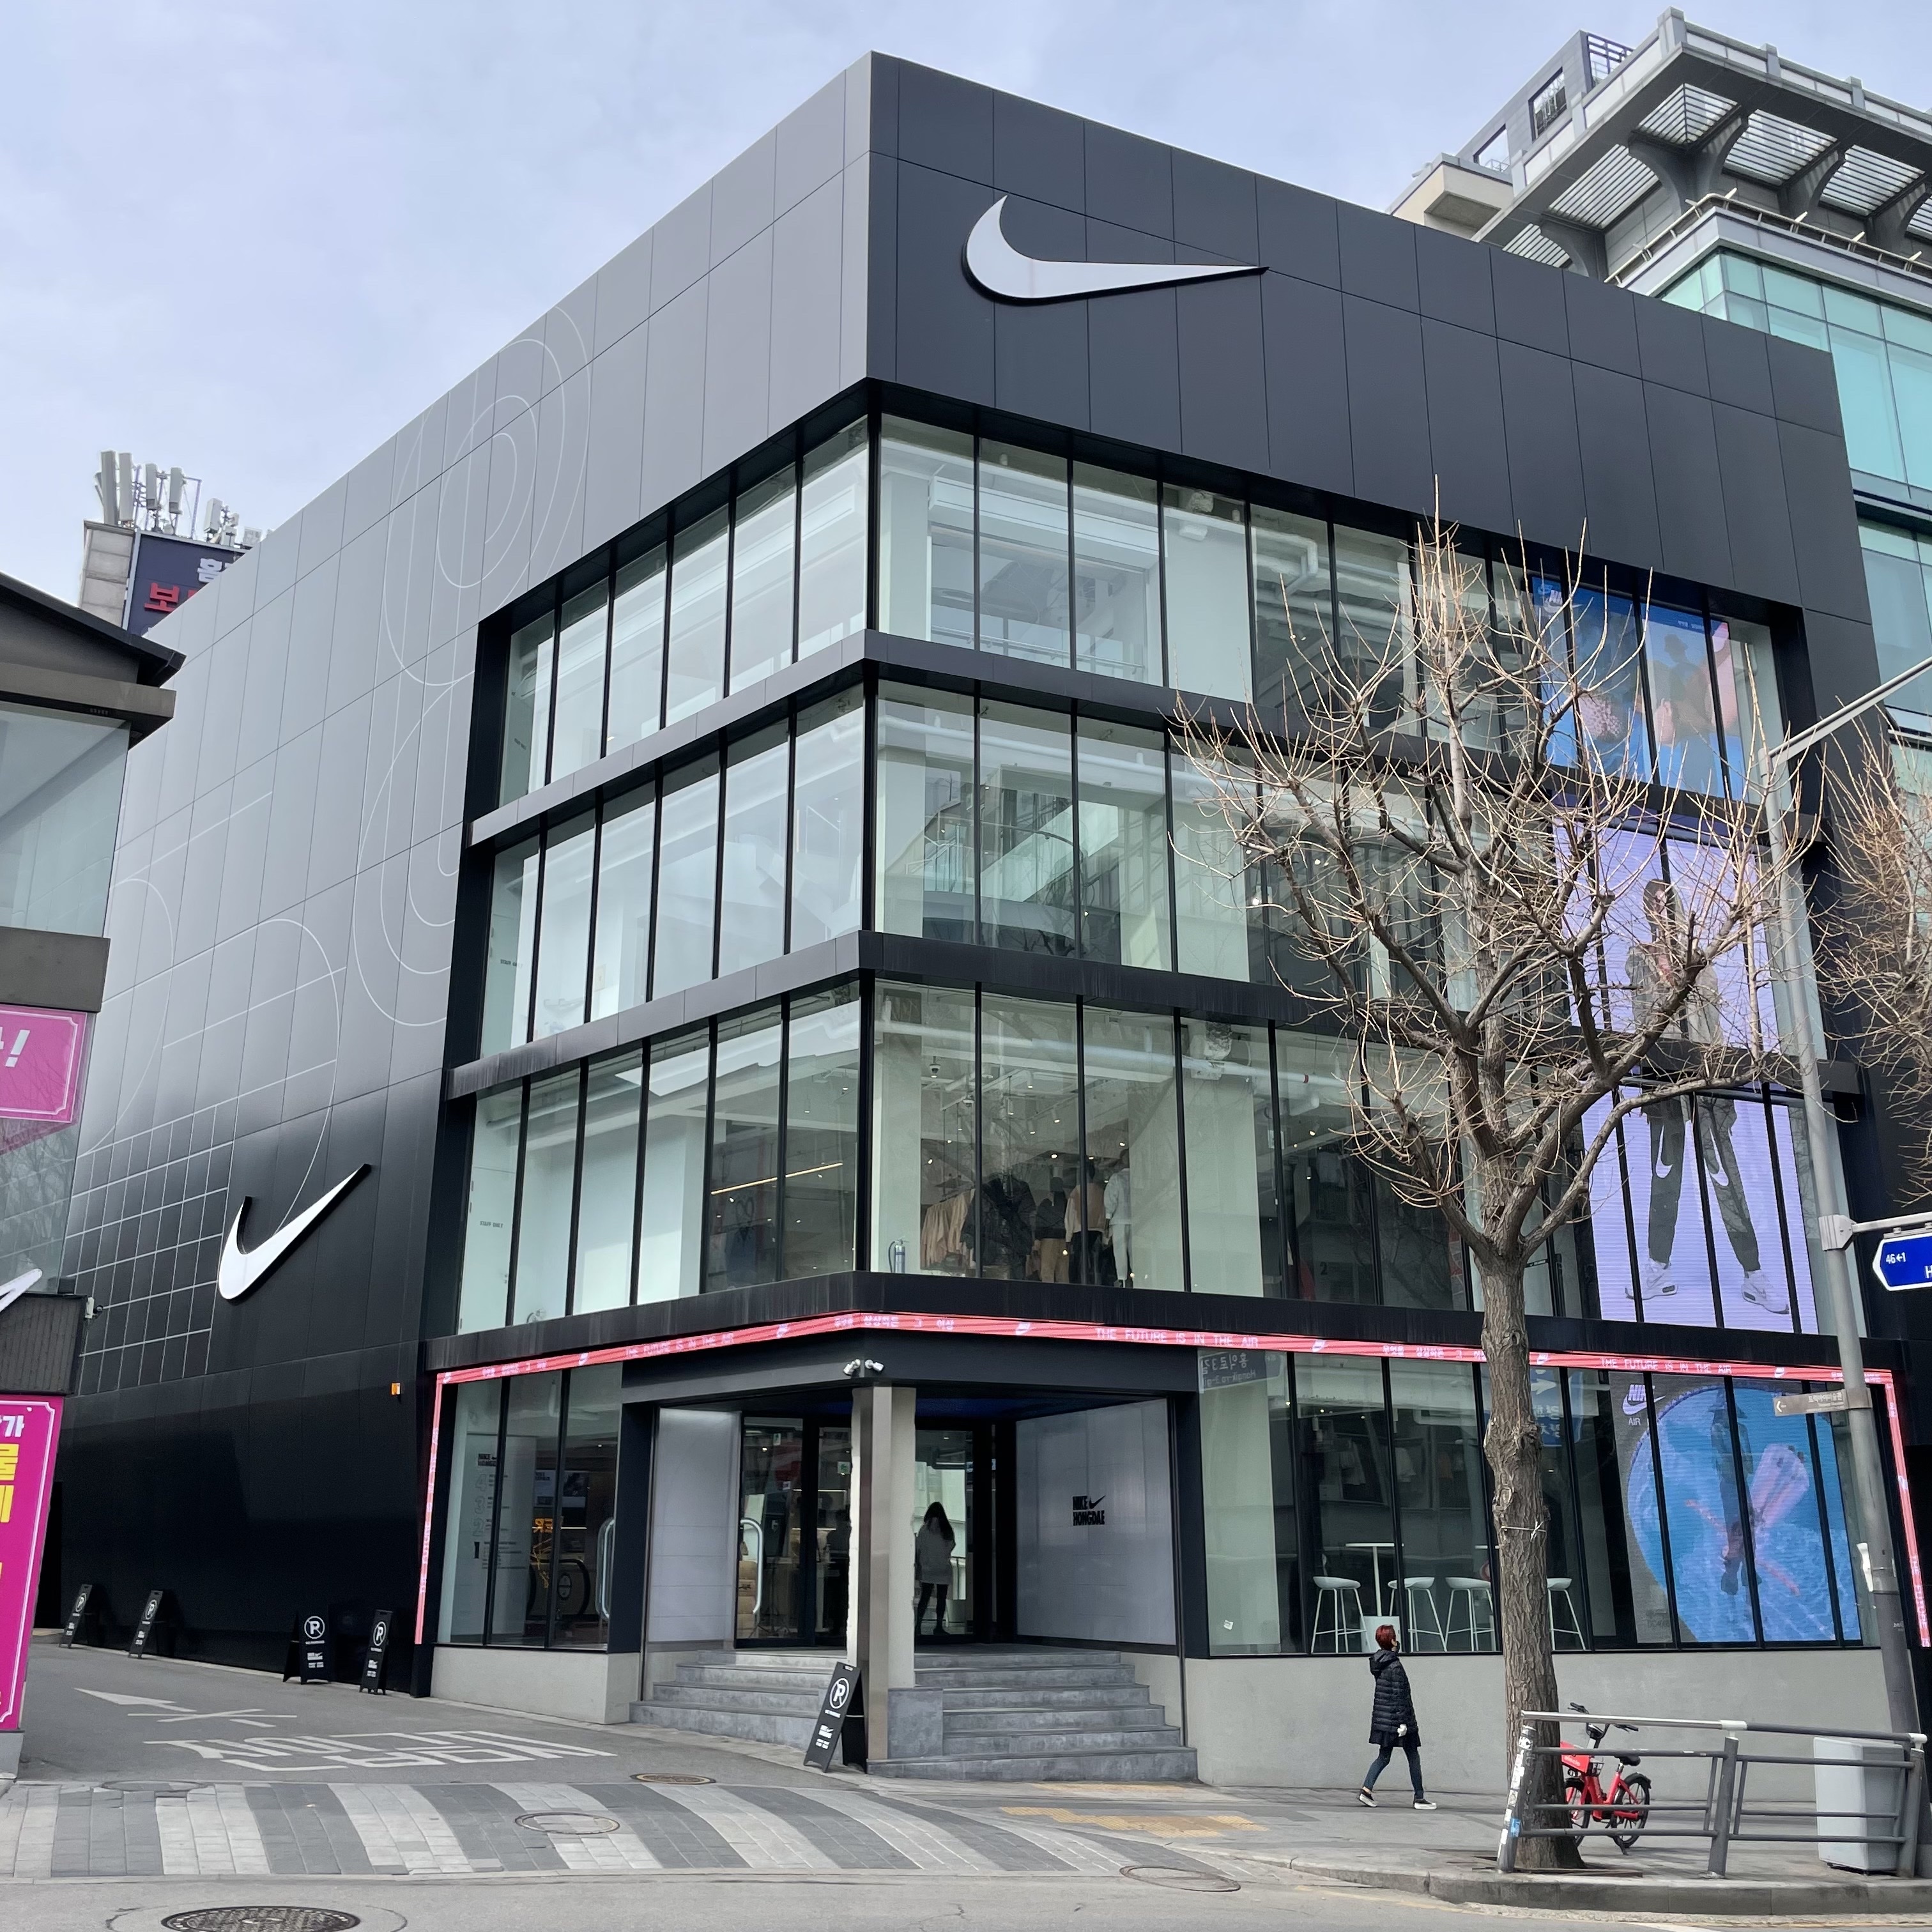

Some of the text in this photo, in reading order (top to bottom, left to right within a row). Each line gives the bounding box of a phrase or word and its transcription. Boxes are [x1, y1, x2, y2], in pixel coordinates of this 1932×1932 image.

[1095, 1327, 1259, 1347] THE FUTURE IS IN THE AIR
[1600, 1357, 1732, 1374] THE FUTURE IS IN THE AIR
[0, 1414, 25, 1438] 가
[1628, 1417, 1641, 1426] AIR
[1073, 1510, 1105, 1526] HONGDAE
